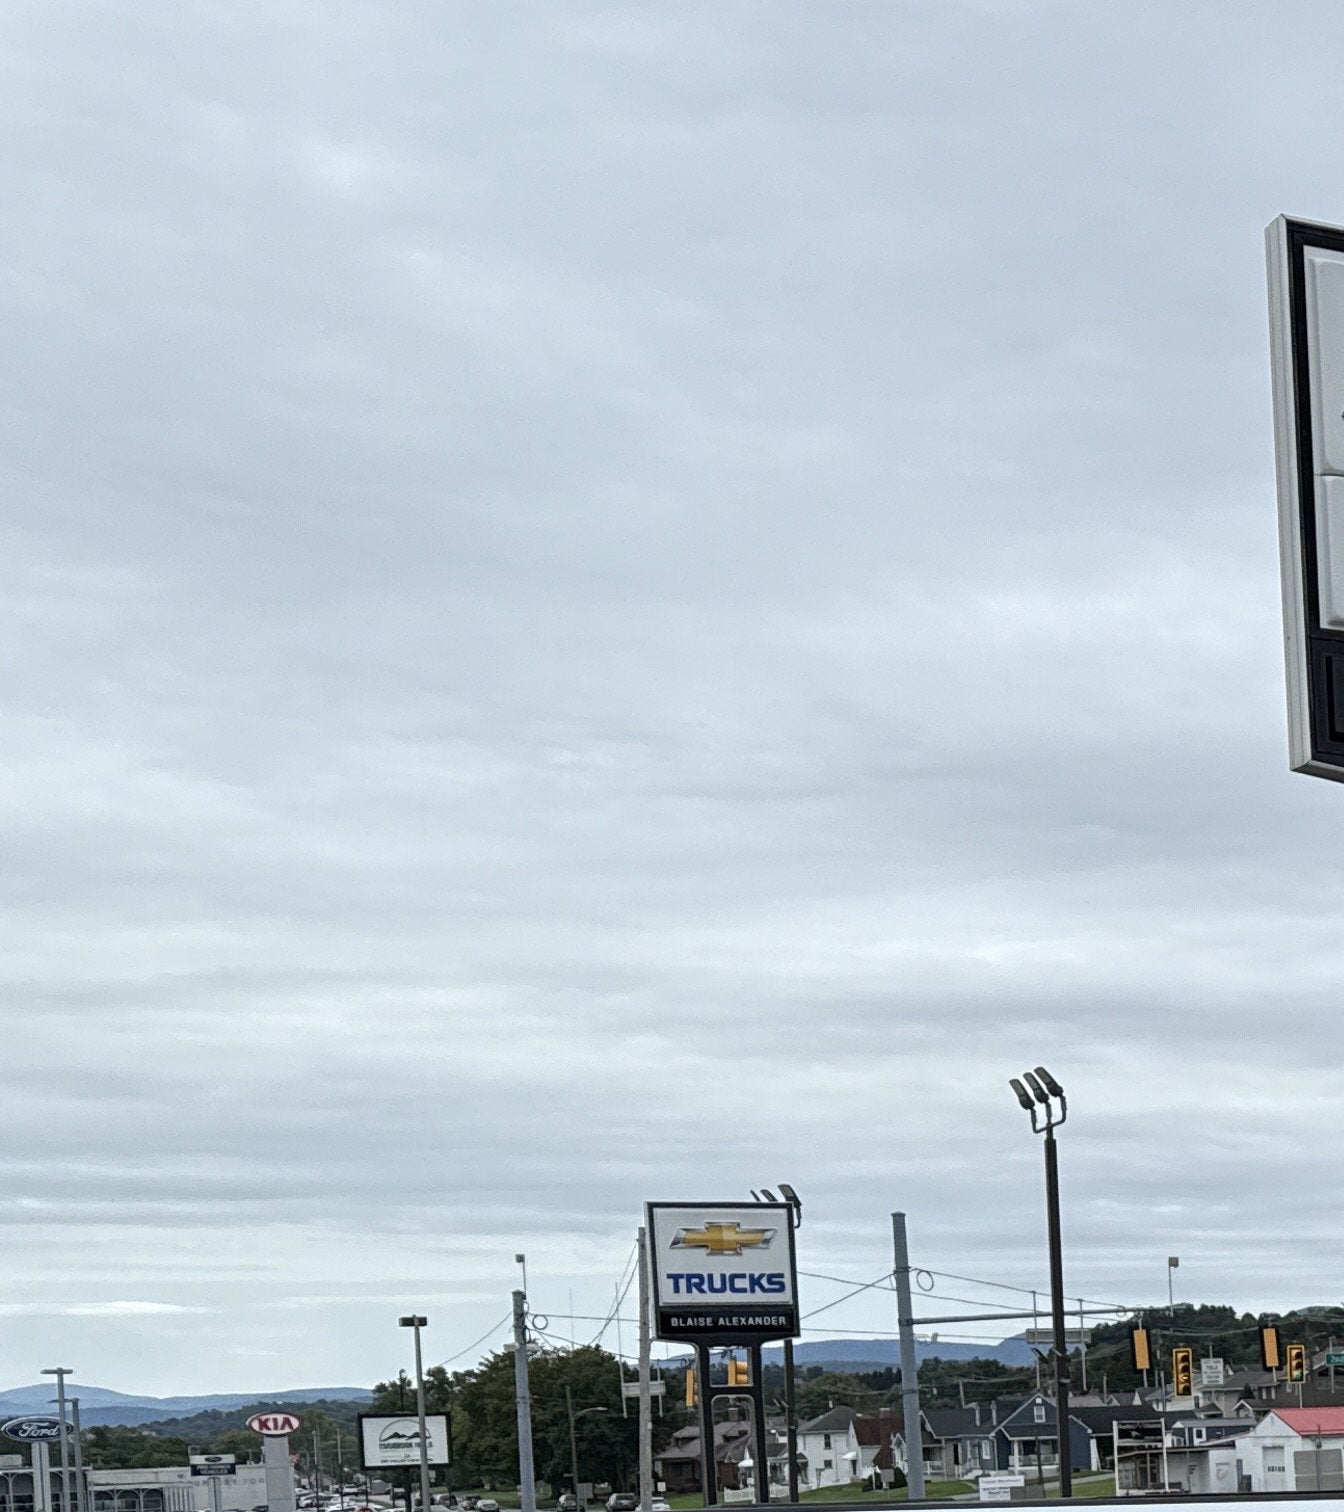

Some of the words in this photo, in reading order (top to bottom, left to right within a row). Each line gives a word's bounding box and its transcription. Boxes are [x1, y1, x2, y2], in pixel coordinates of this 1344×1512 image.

[667, 1273, 785, 1293] TRUCKS
[671, 1317, 713, 1326] BLAISE
[718, 1316, 786, 1326] ALEXANDER
[18, 1422, 60, 1437] Ford
[258, 1417, 294, 1431] KIA
